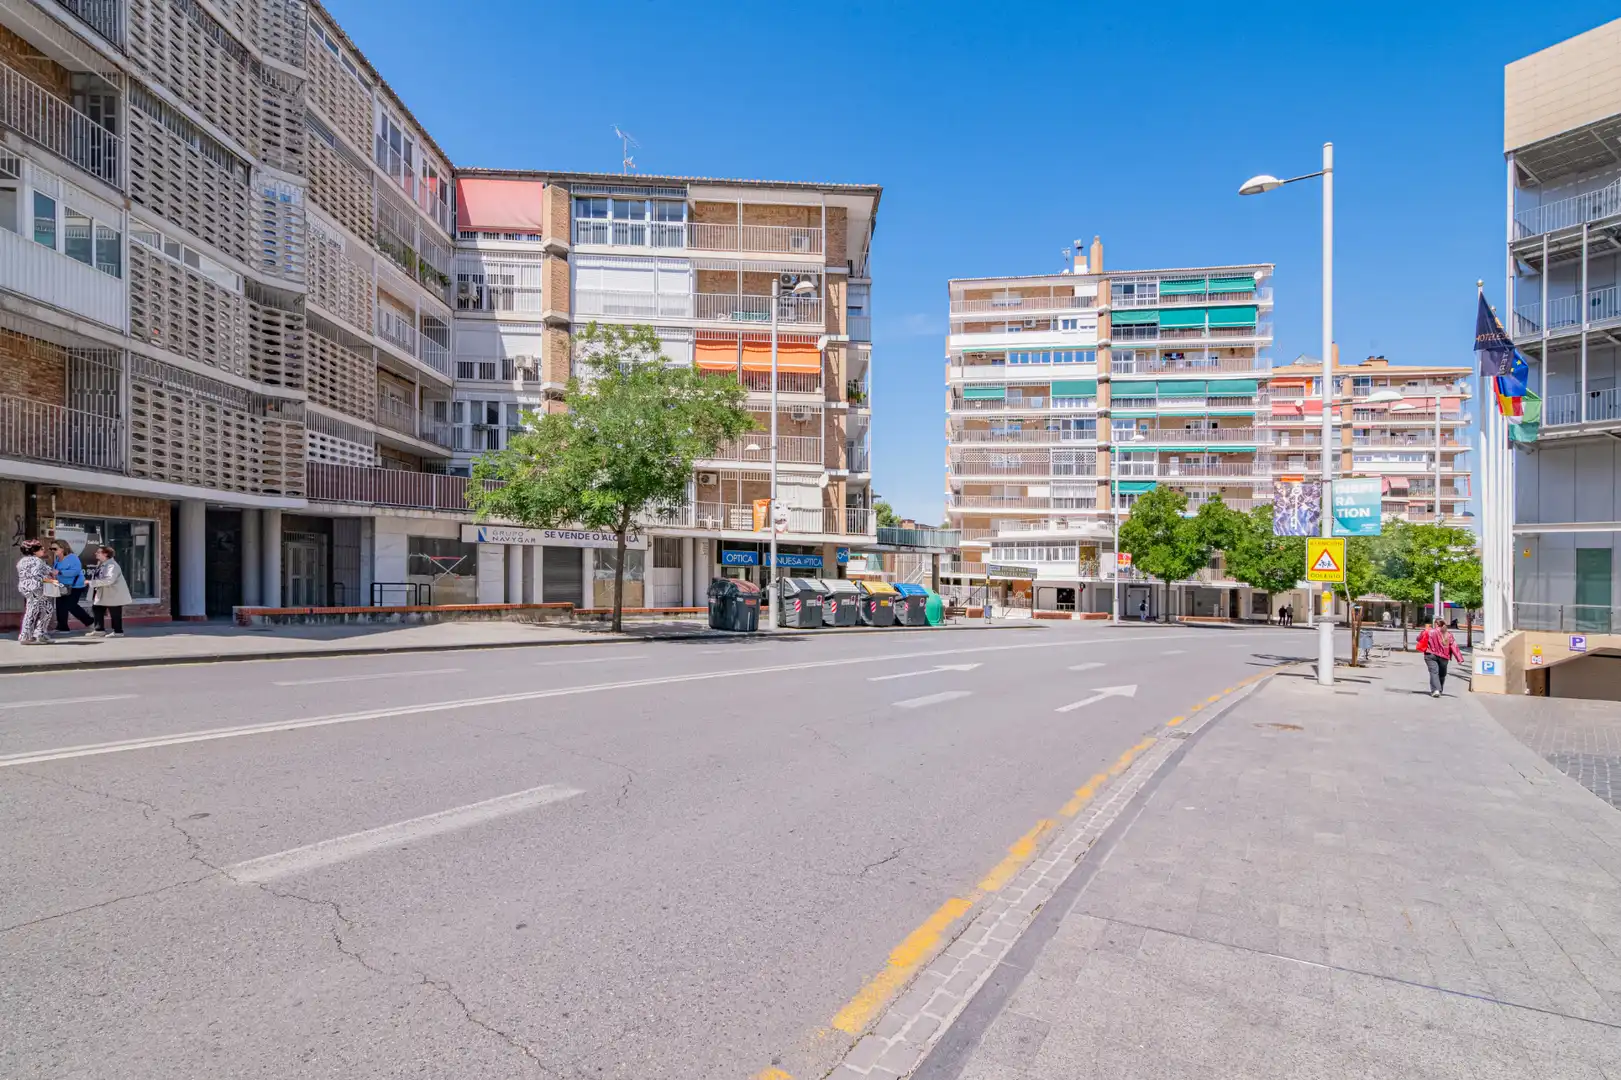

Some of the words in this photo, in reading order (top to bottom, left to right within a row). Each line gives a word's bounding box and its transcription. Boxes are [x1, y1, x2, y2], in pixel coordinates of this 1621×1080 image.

[1335, 496, 1355, 506] RA
[1336, 507, 1370, 518] TION
[492, 536, 536, 544] NAVYGAR
[544, 530, 556, 539] SE
[558, 531, 590, 541] VENDE
[592, 533, 600, 541] O
[601, 534, 640, 544] ALQILA
[1572, 637, 1584, 646] P
[1484, 661, 1493, 671] P
